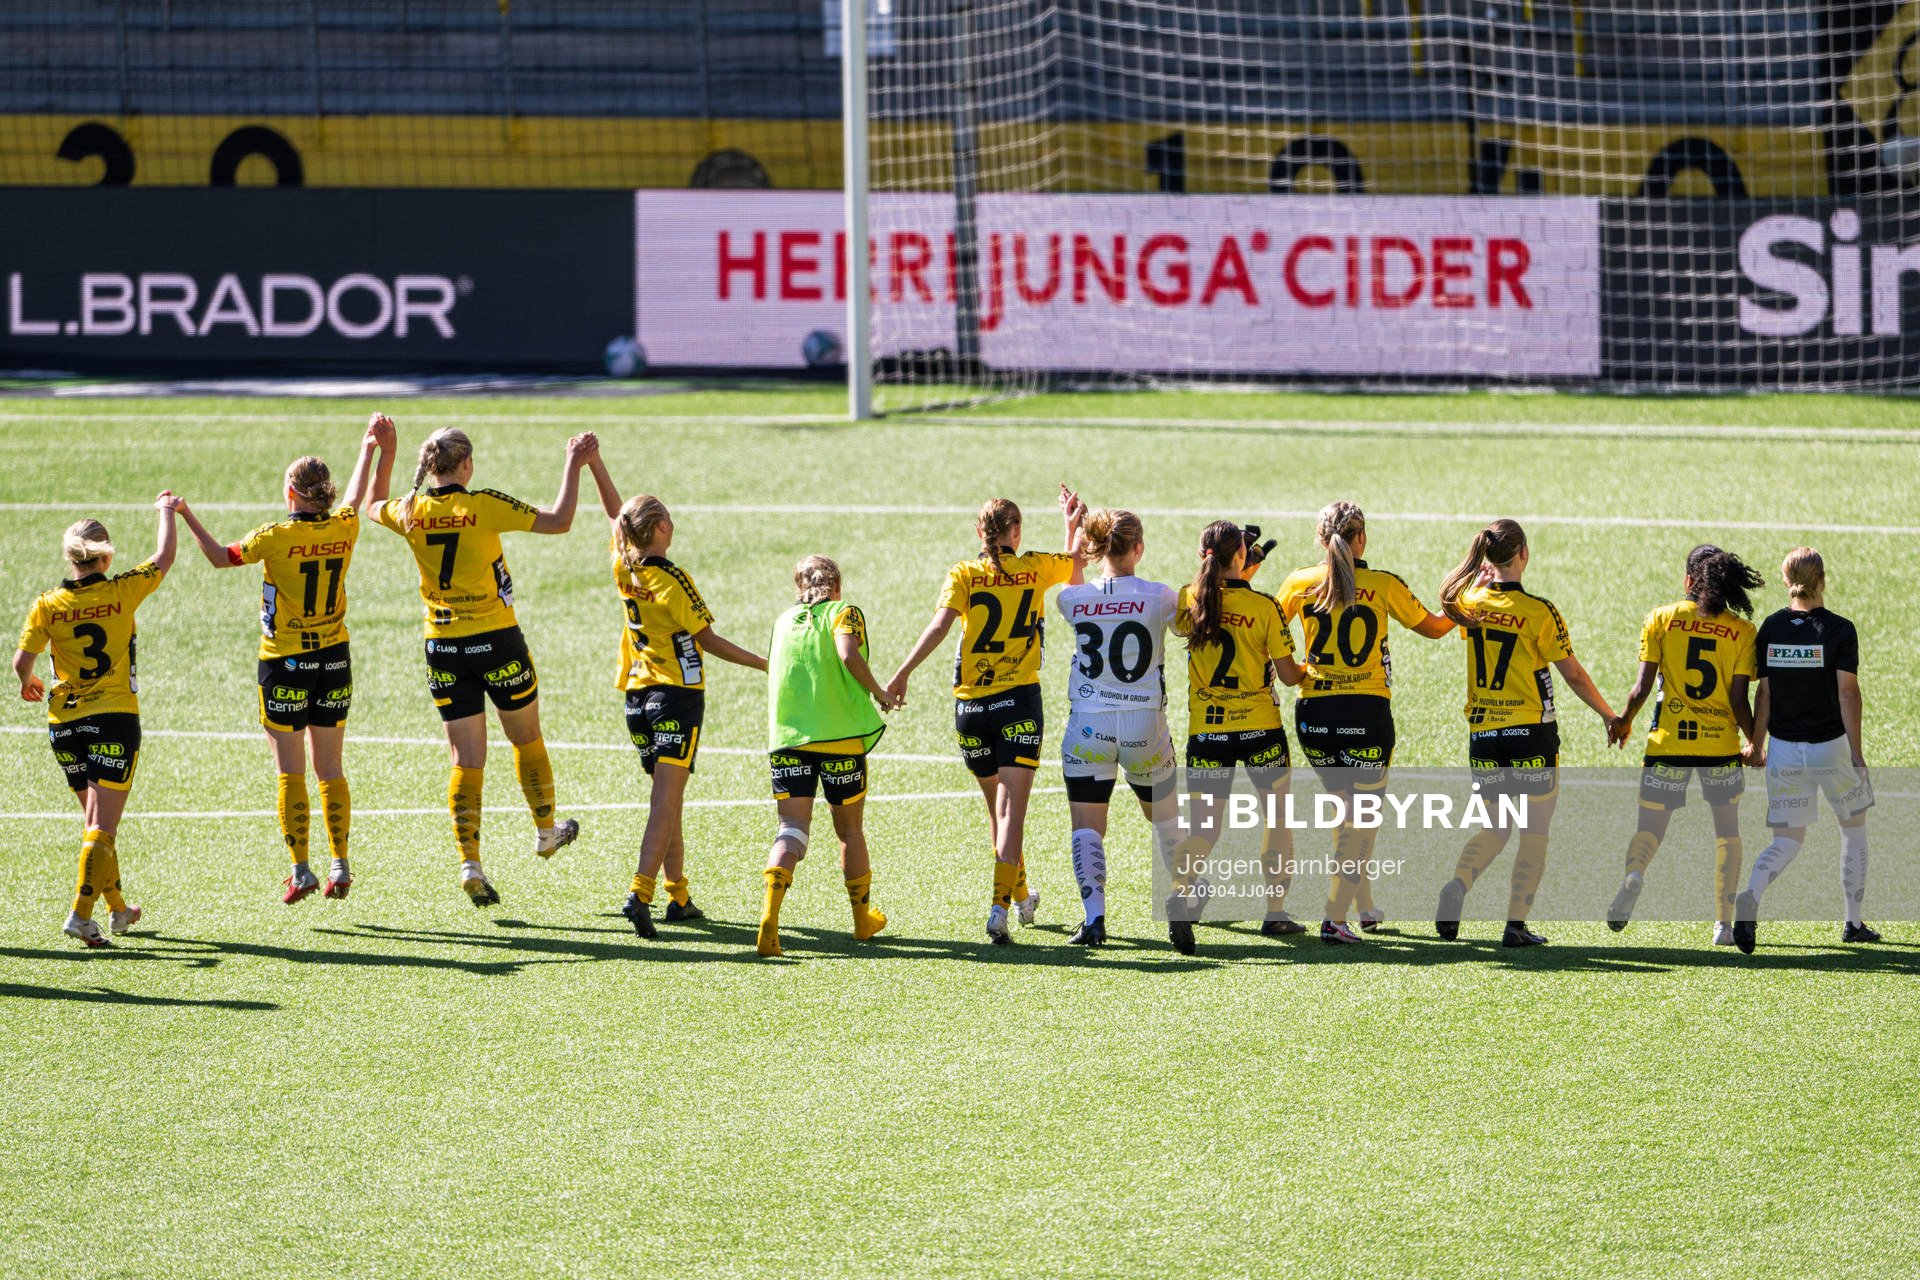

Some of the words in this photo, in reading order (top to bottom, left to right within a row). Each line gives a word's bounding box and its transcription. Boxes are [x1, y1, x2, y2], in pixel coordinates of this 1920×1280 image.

[1284, 236, 1533, 309] CIDER
[410, 514, 477, 531] PULSEN
[288, 540, 352, 558] PULSEN
[425, 532, 460, 590] 7
[300, 558, 344, 617] 11
[971, 572, 1038, 588] PULSEN
[51, 601, 121, 625] PULSEN
[1073, 601, 1145, 617] PULSEN
[970, 589, 1038, 653] 24
[1220, 611, 1255, 629] SEN
[1302, 603, 1378, 667] 20
[1668, 620, 1739, 641] PULSEN
[73, 623, 112, 680] 3
[465, 643, 492, 654] LOGISTICS
[1075, 621, 1153, 683] 30
[1773, 648, 1814, 658] PEAB
[325, 660, 347, 670] LOGISTICS
[1209, 627, 1239, 689] 2
[1467, 627, 1518, 690] 17
[487, 662, 519, 682] EAB
[1685, 636, 1718, 700] 5
[276, 688, 306, 700] EAB
[1100, 690, 1129, 700] RUDHOLM
[988, 699, 1015, 711] LOGISTICS
[1005, 721, 1034, 738] EAB
[1240, 730, 1266, 740] LOGISTICS
[1337, 727, 1366, 735] LOGISTICS
[1502, 728, 1530, 736] LOGISTICS
[1120, 740, 1148, 748] LOGISTICS
[1253, 746, 1280, 763] EAB
[823, 760, 854, 773] EAB
[1512, 758, 1542, 769] EAB
[1656, 764, 1685, 779] EAB
[1073, 838, 1086, 884] VINNERG
